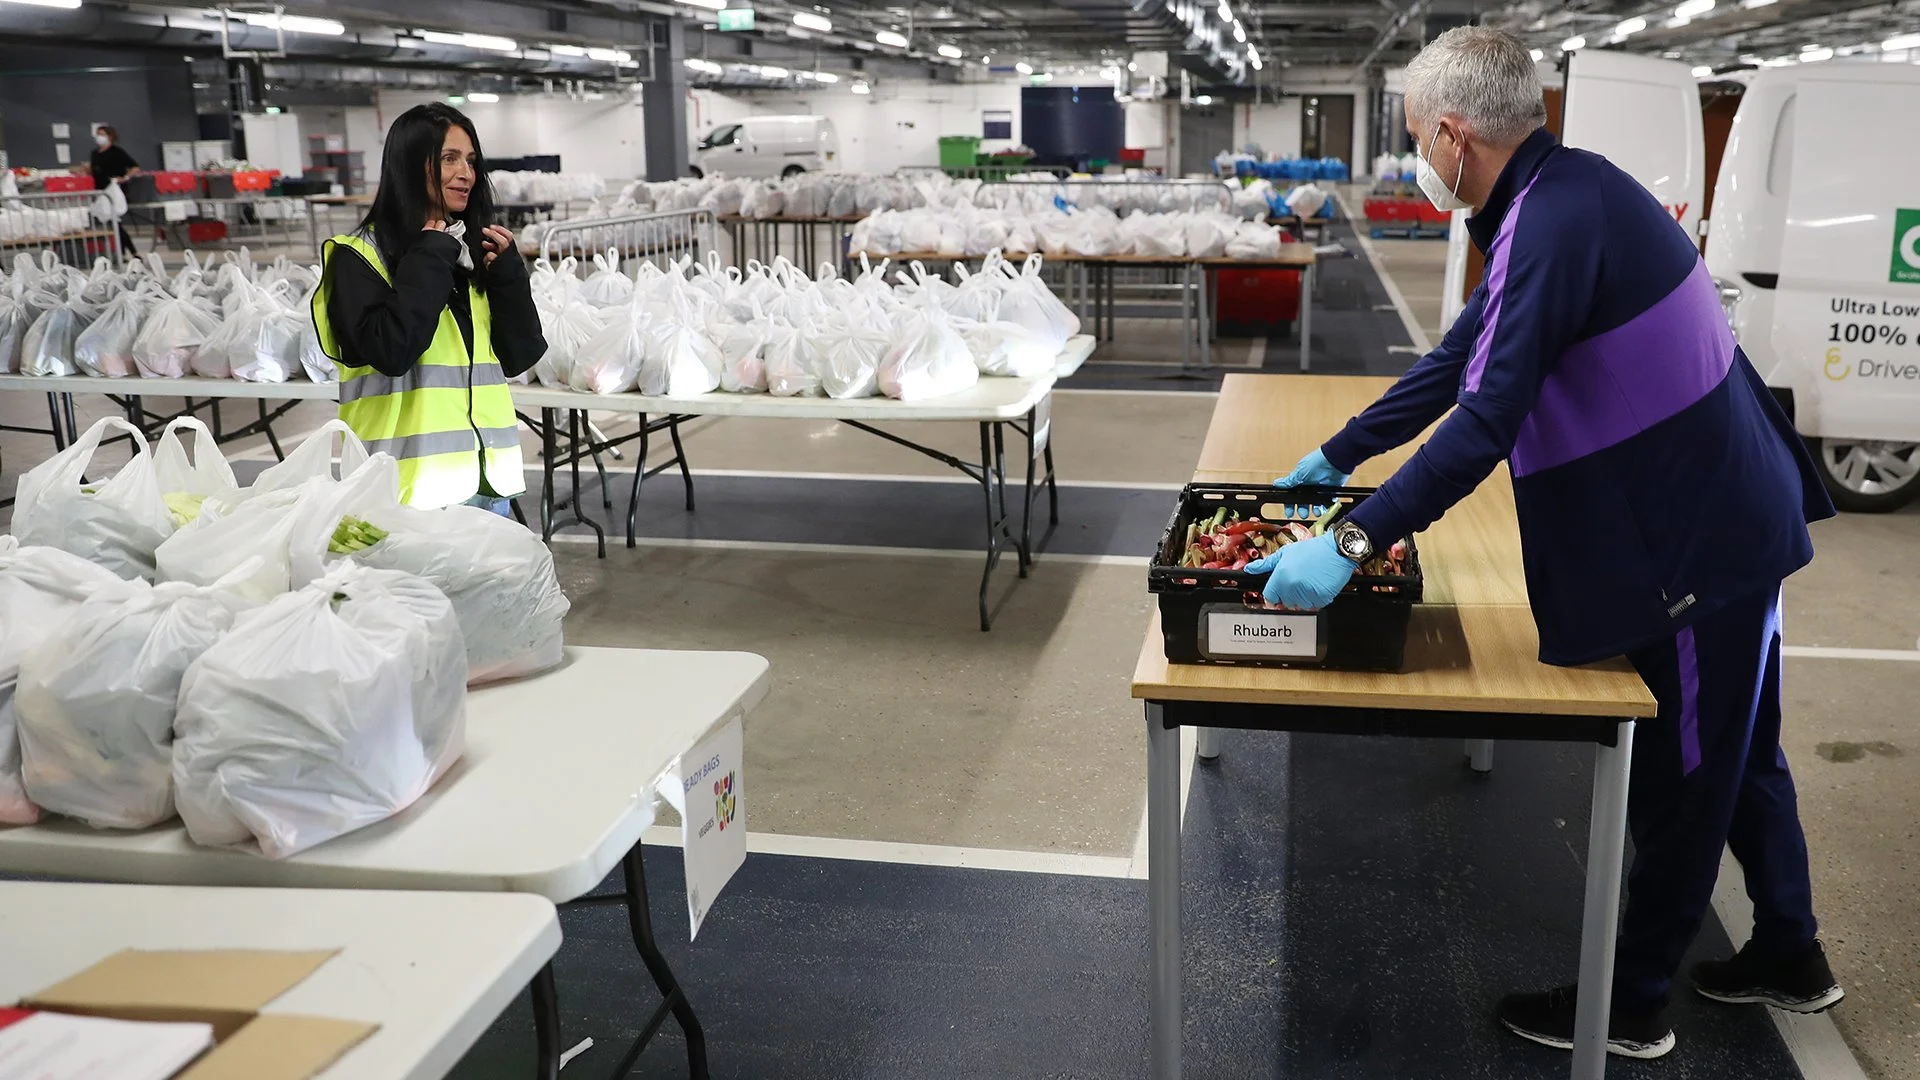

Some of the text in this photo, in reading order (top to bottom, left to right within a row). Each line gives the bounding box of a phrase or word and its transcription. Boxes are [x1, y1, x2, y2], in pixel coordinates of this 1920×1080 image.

[1831, 298, 1920, 317] Ultra Low
[1828, 322, 1906, 346] 100%
[1858, 358, 1920, 380] Drive
[1233, 624, 1292, 637] Rhubarb
[703, 753, 720, 777] BAGS
